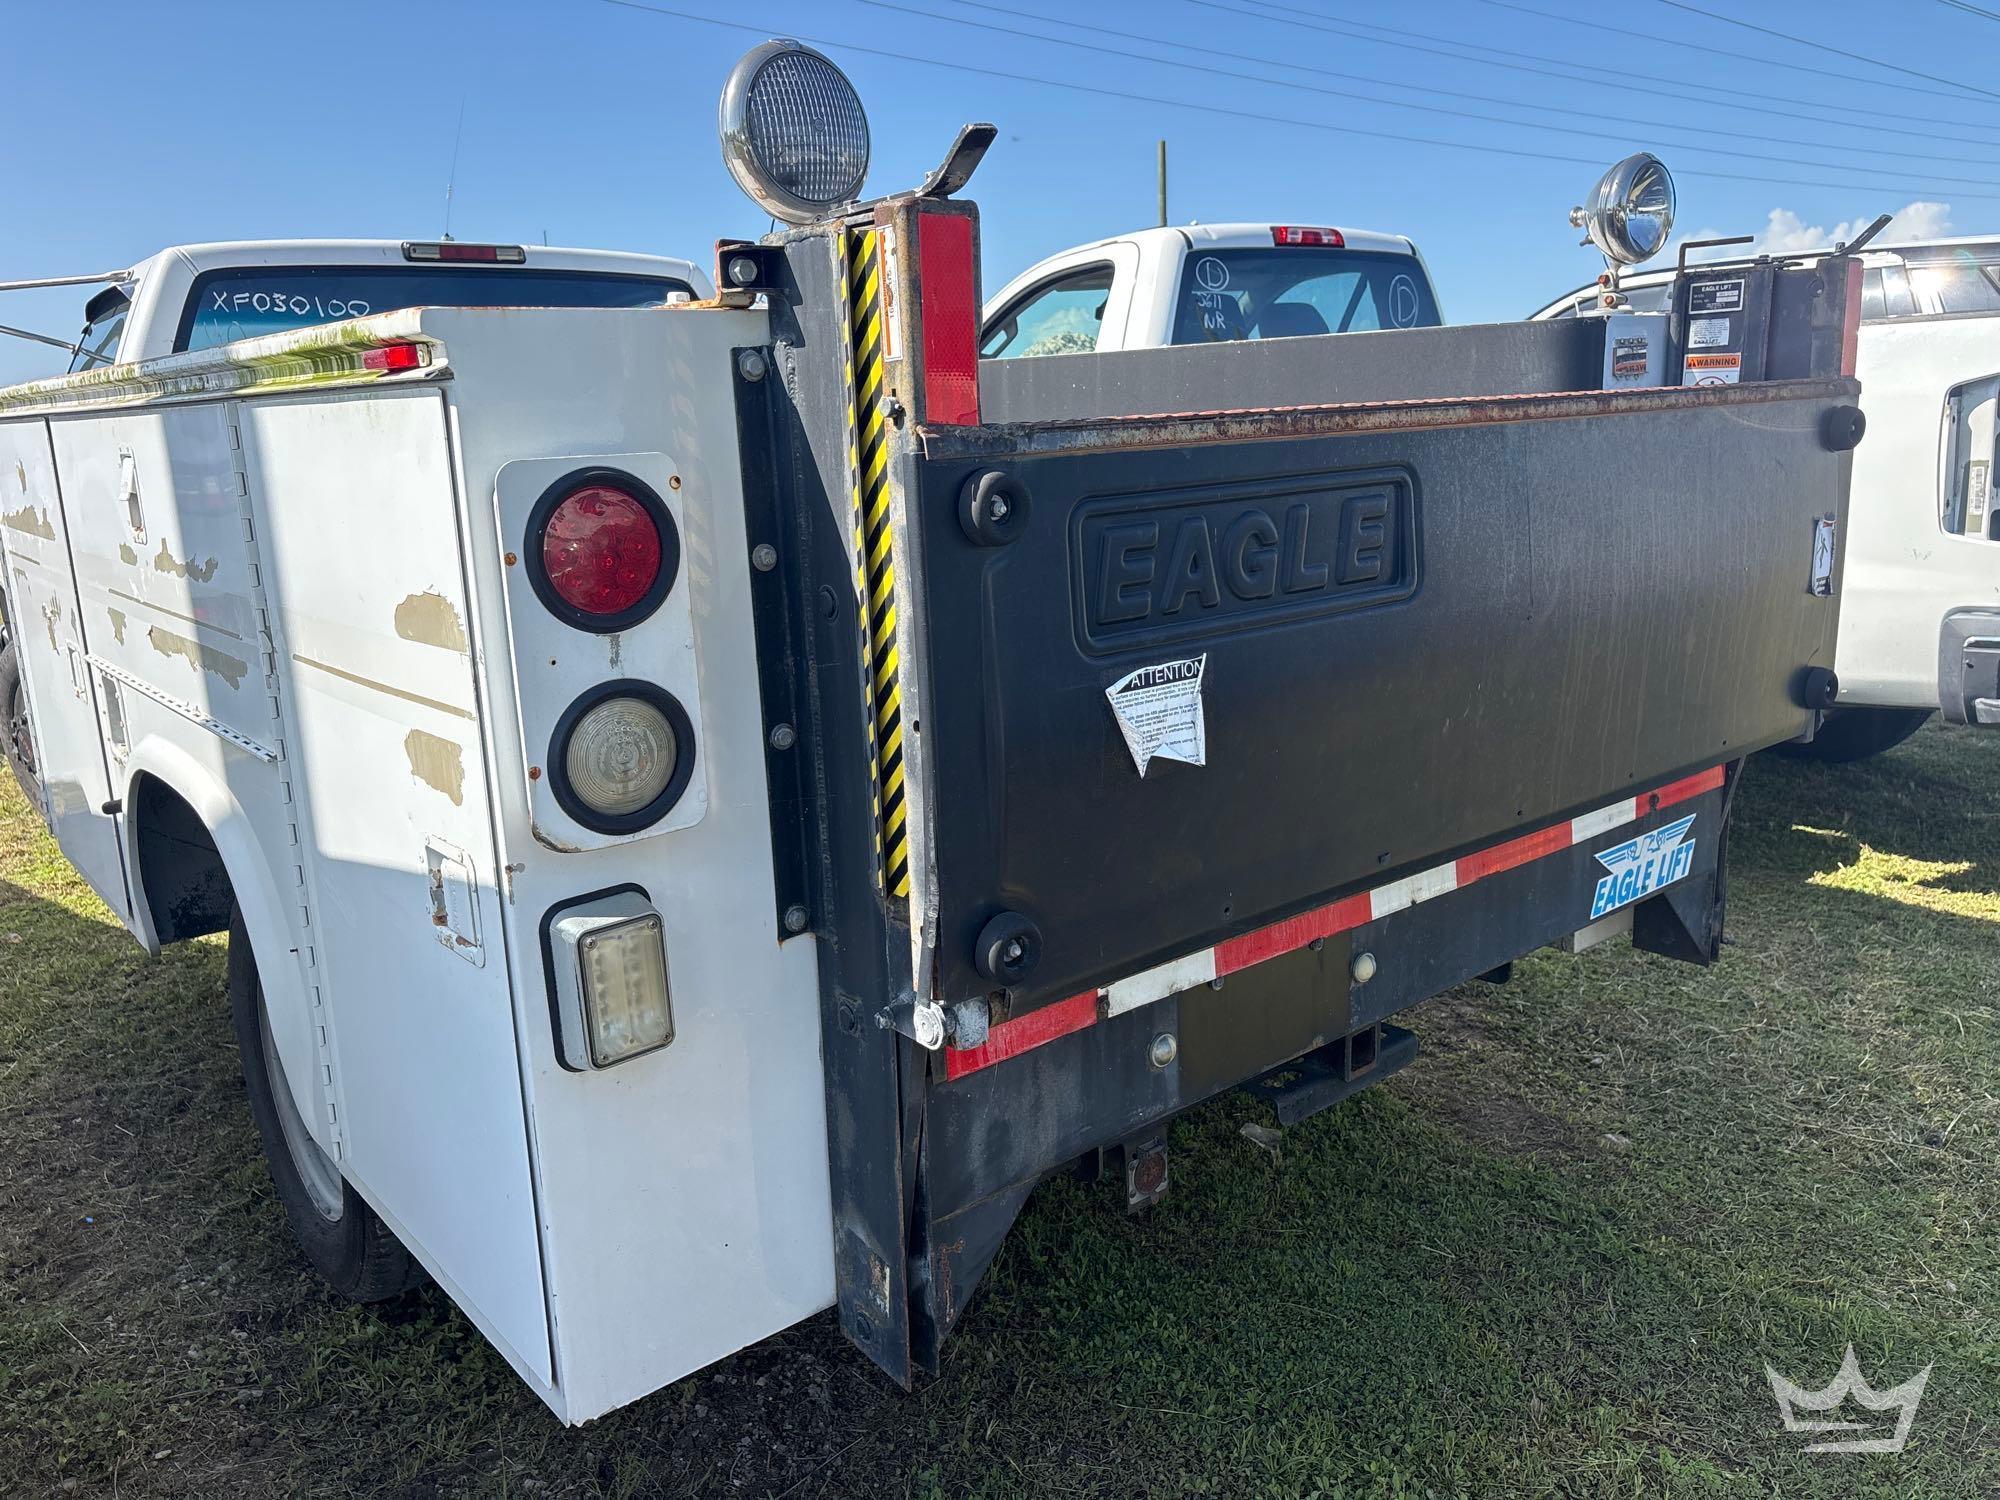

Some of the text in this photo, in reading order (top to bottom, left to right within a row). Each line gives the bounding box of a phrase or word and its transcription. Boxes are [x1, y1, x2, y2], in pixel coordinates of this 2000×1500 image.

[1204, 313, 1226, 329] NR
[1696, 358, 1737, 367] WARNING
[1096, 493, 1388, 625] EAGLE
[1131, 661, 1201, 688] ATTENTION
[1592, 842, 1694, 917] EAGLE LIFT
